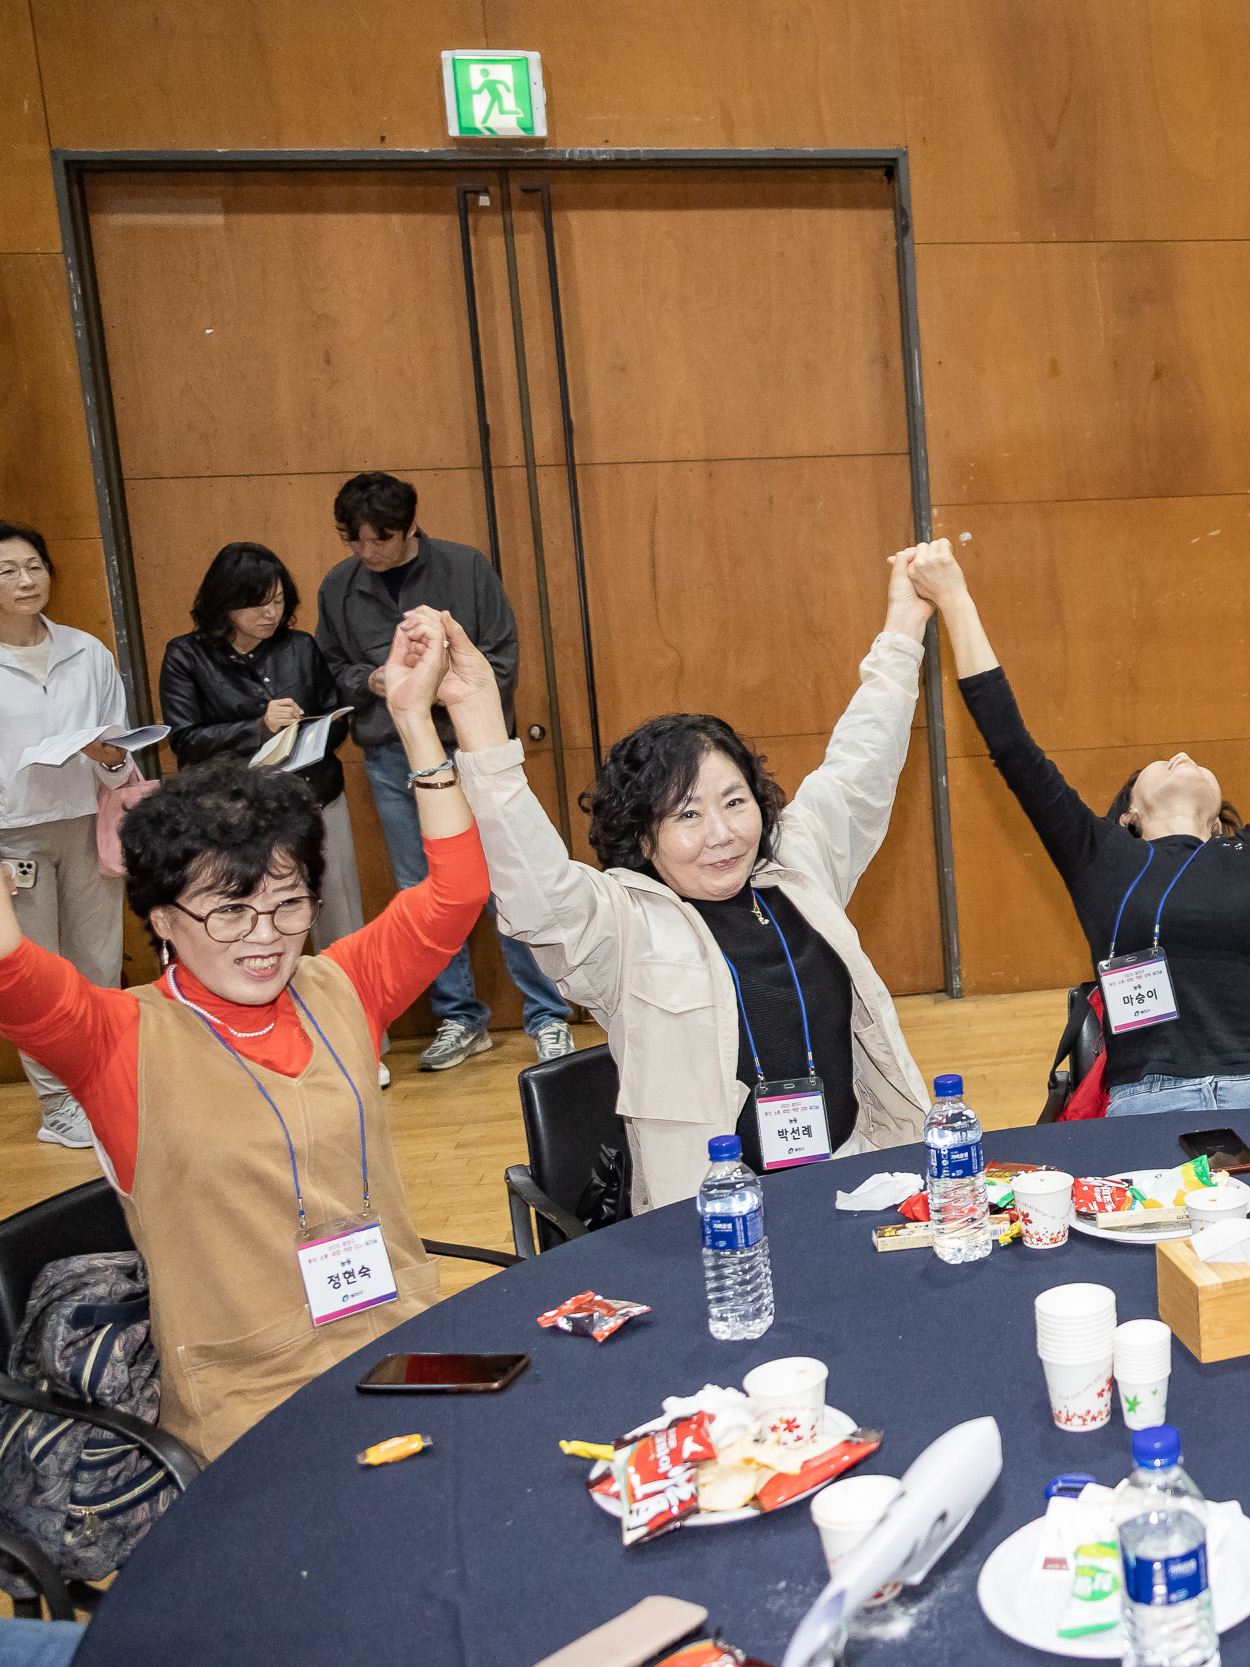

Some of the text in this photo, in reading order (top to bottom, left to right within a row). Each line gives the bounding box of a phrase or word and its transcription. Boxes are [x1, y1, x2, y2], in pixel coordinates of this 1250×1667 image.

[1123, 989, 1158, 1006] 마승이
[778, 1125, 813, 1141] 박선례
[327, 1265, 372, 1289] 정현숙
